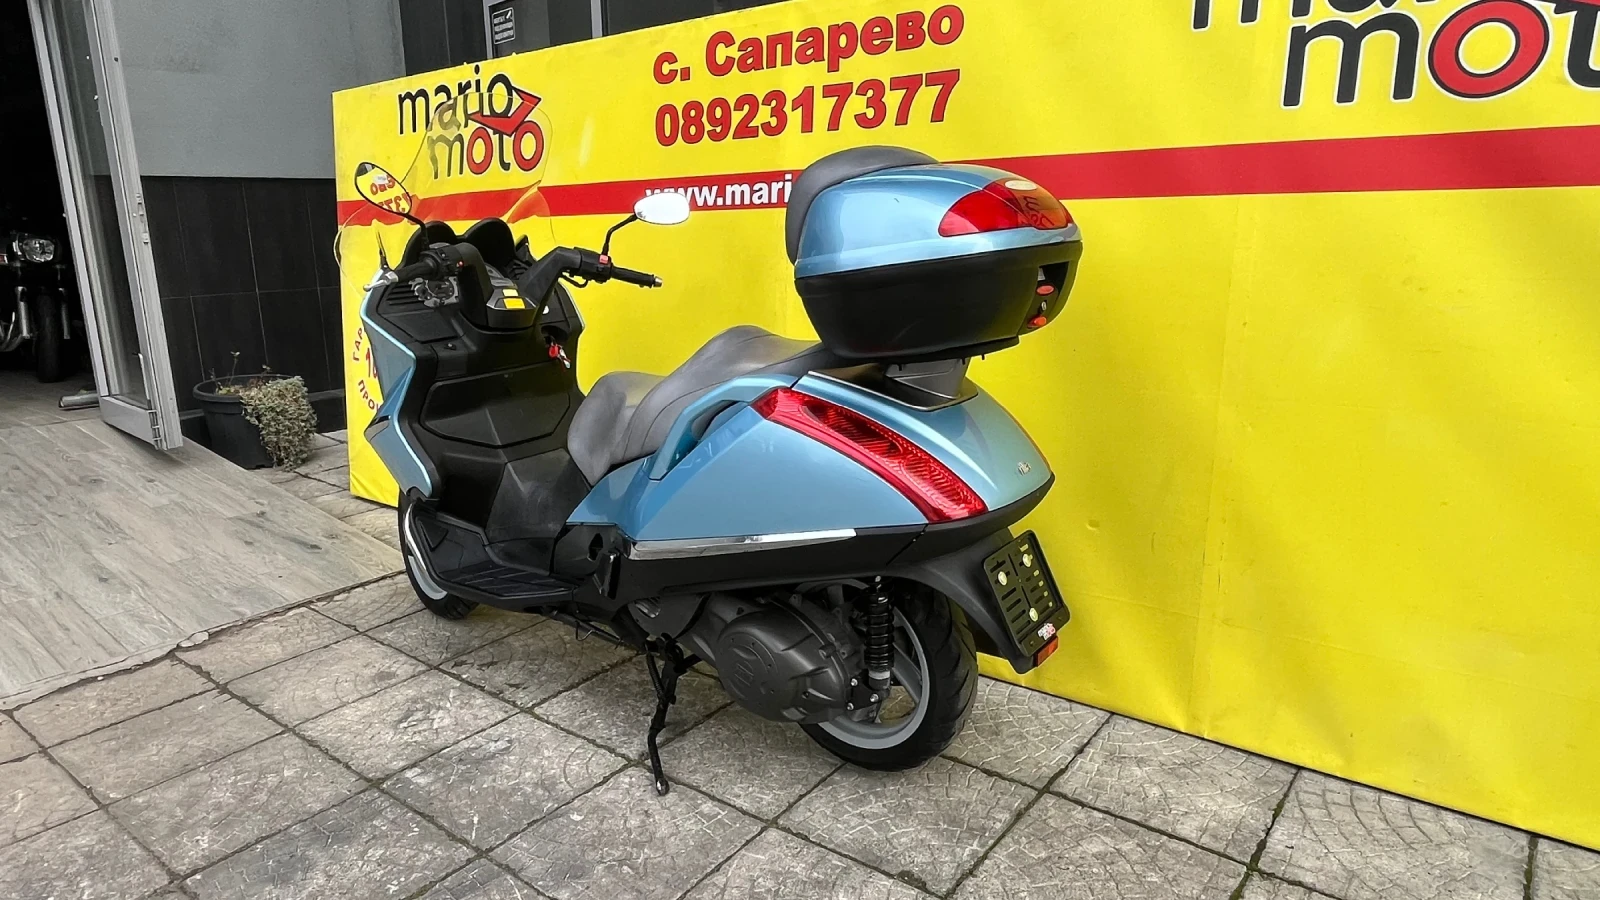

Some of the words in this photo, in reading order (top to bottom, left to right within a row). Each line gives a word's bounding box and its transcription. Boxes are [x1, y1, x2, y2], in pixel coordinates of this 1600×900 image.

[653, 51, 691, 84] с.
[705, 4, 965, 77] Сапарево
[1282, 0, 1600, 107] mot
[397, 64, 515, 135] mario
[655, 69, 961, 147] 0892317377
[426, 119, 546, 180] moto
[352, 327, 364, 362] ГАР
